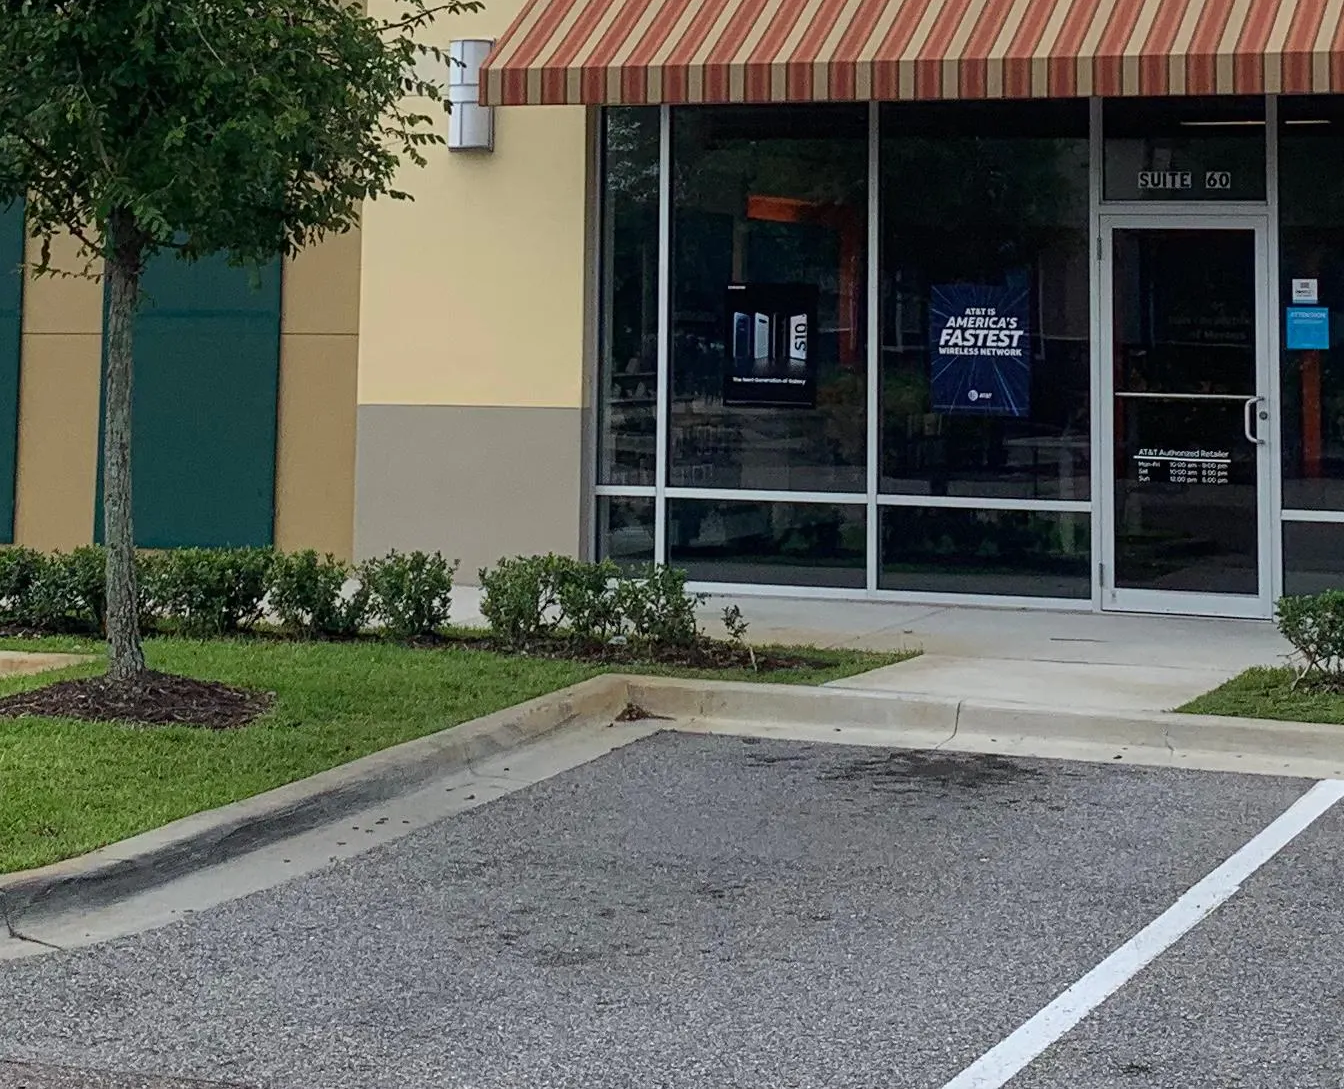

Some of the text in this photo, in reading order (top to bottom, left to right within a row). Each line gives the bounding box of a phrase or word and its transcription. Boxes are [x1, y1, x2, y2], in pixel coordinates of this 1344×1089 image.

[1138, 172, 1231, 188] SUITE 60
[965, 308, 996, 316] AT&T IS
[945, 316, 1018, 329] AMERICA'S
[795, 323, 807, 351] S10
[939, 329, 1024, 347] FASTEST
[938, 347, 1022, 357] WIRELESS NETWORK
[1159, 449, 1199, 458] Authorized
[1200, 450, 1229, 458] Retailer
